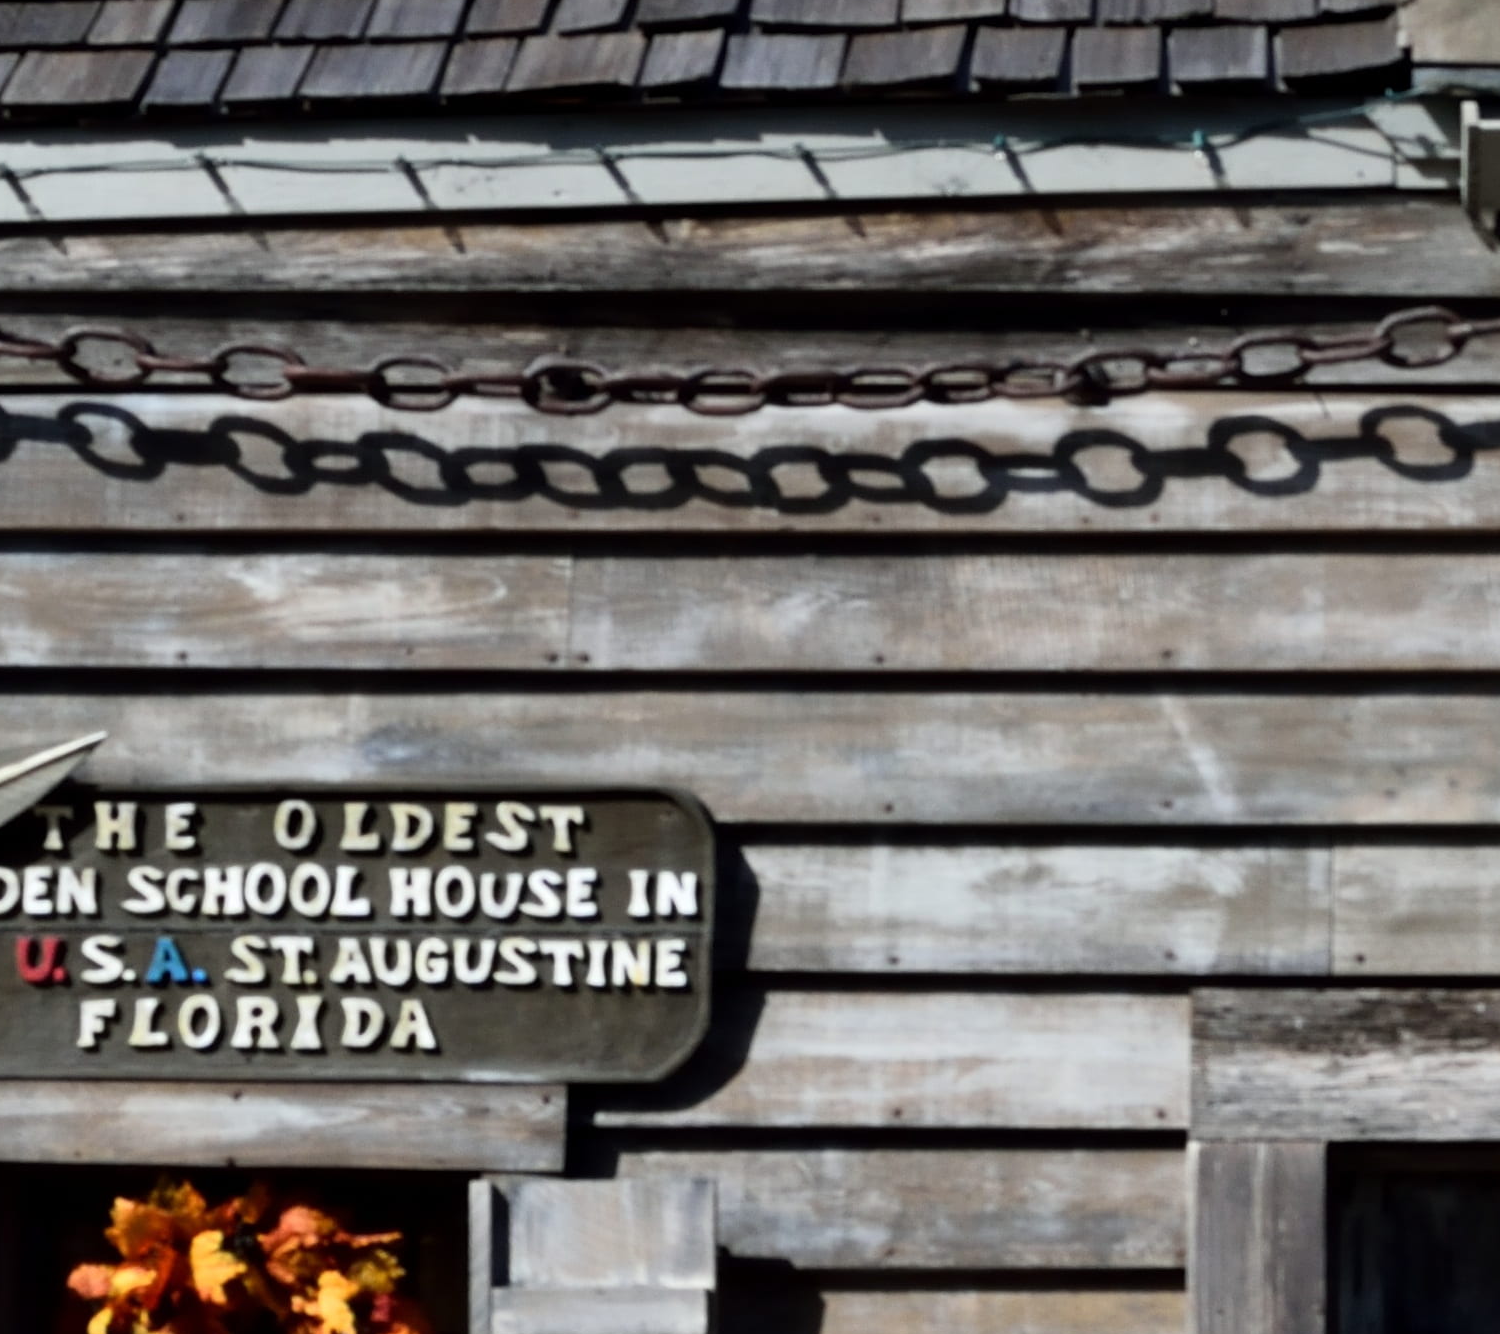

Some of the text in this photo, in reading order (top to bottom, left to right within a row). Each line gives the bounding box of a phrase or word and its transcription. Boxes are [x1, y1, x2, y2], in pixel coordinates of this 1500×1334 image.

[35, 798, 585, 853] THE OLDEST
[120, 861, 372, 917] SCHOOL
[388, 865, 599, 919] HOUSE
[626, 869, 698, 916] IN
[329, 936, 688, 988] AUGUSTINE
[76, 993, 437, 1050] FLORIDA
